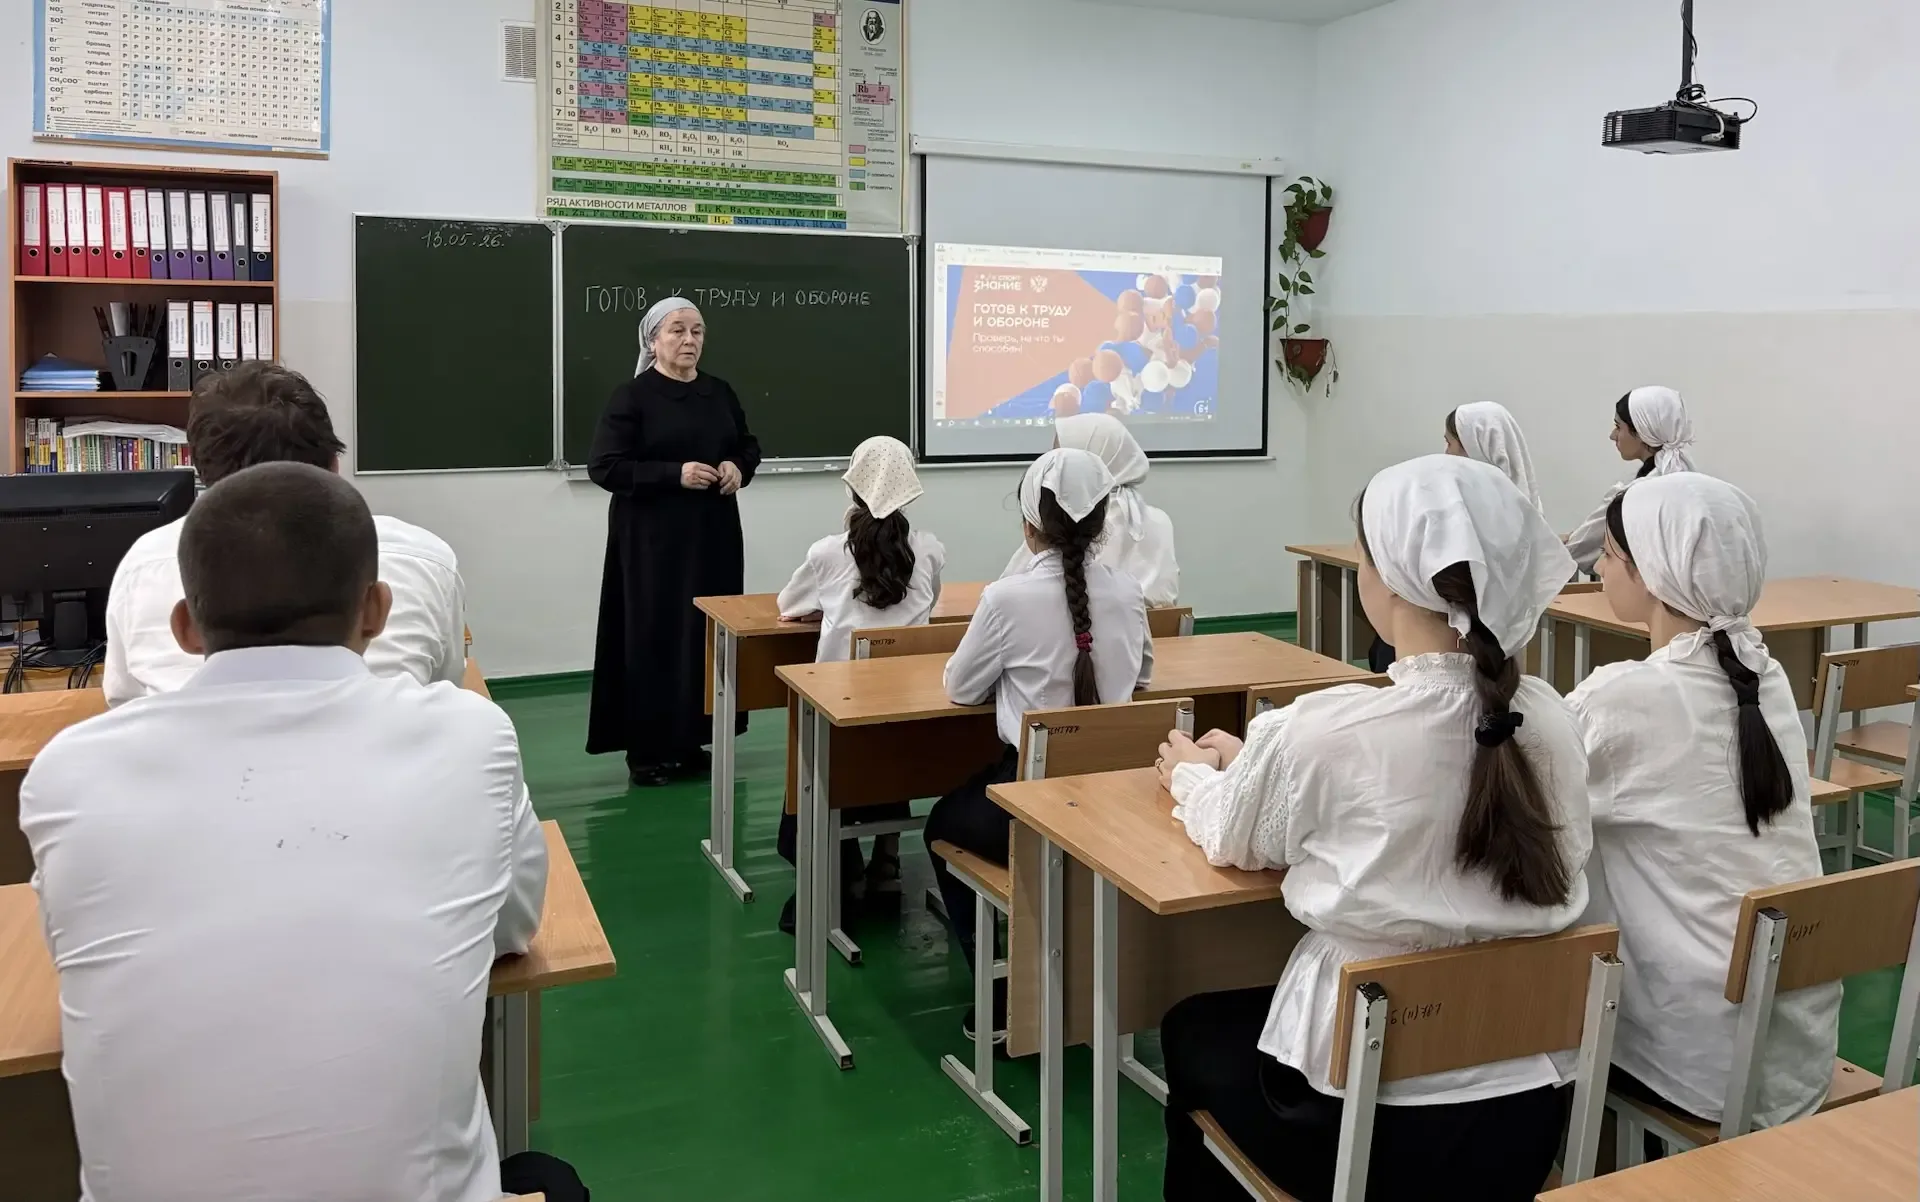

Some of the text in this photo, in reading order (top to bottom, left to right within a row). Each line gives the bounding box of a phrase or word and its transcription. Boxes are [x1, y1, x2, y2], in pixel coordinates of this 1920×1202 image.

[546, 197, 687, 212] РЯД АКТИВНОСТИ МЕТАЛЛОВ
[585, 286, 648, 312] ГОТОВ
[694, 287, 761, 308] ТРУДУ
[772, 291, 786, 308] И
[795, 289, 872, 307] ОБОРОНЕ
[973, 303, 1072, 317] ГОТОВ К ТРУДУ
[973, 316, 1050, 328] И ОБОРОНЕ
